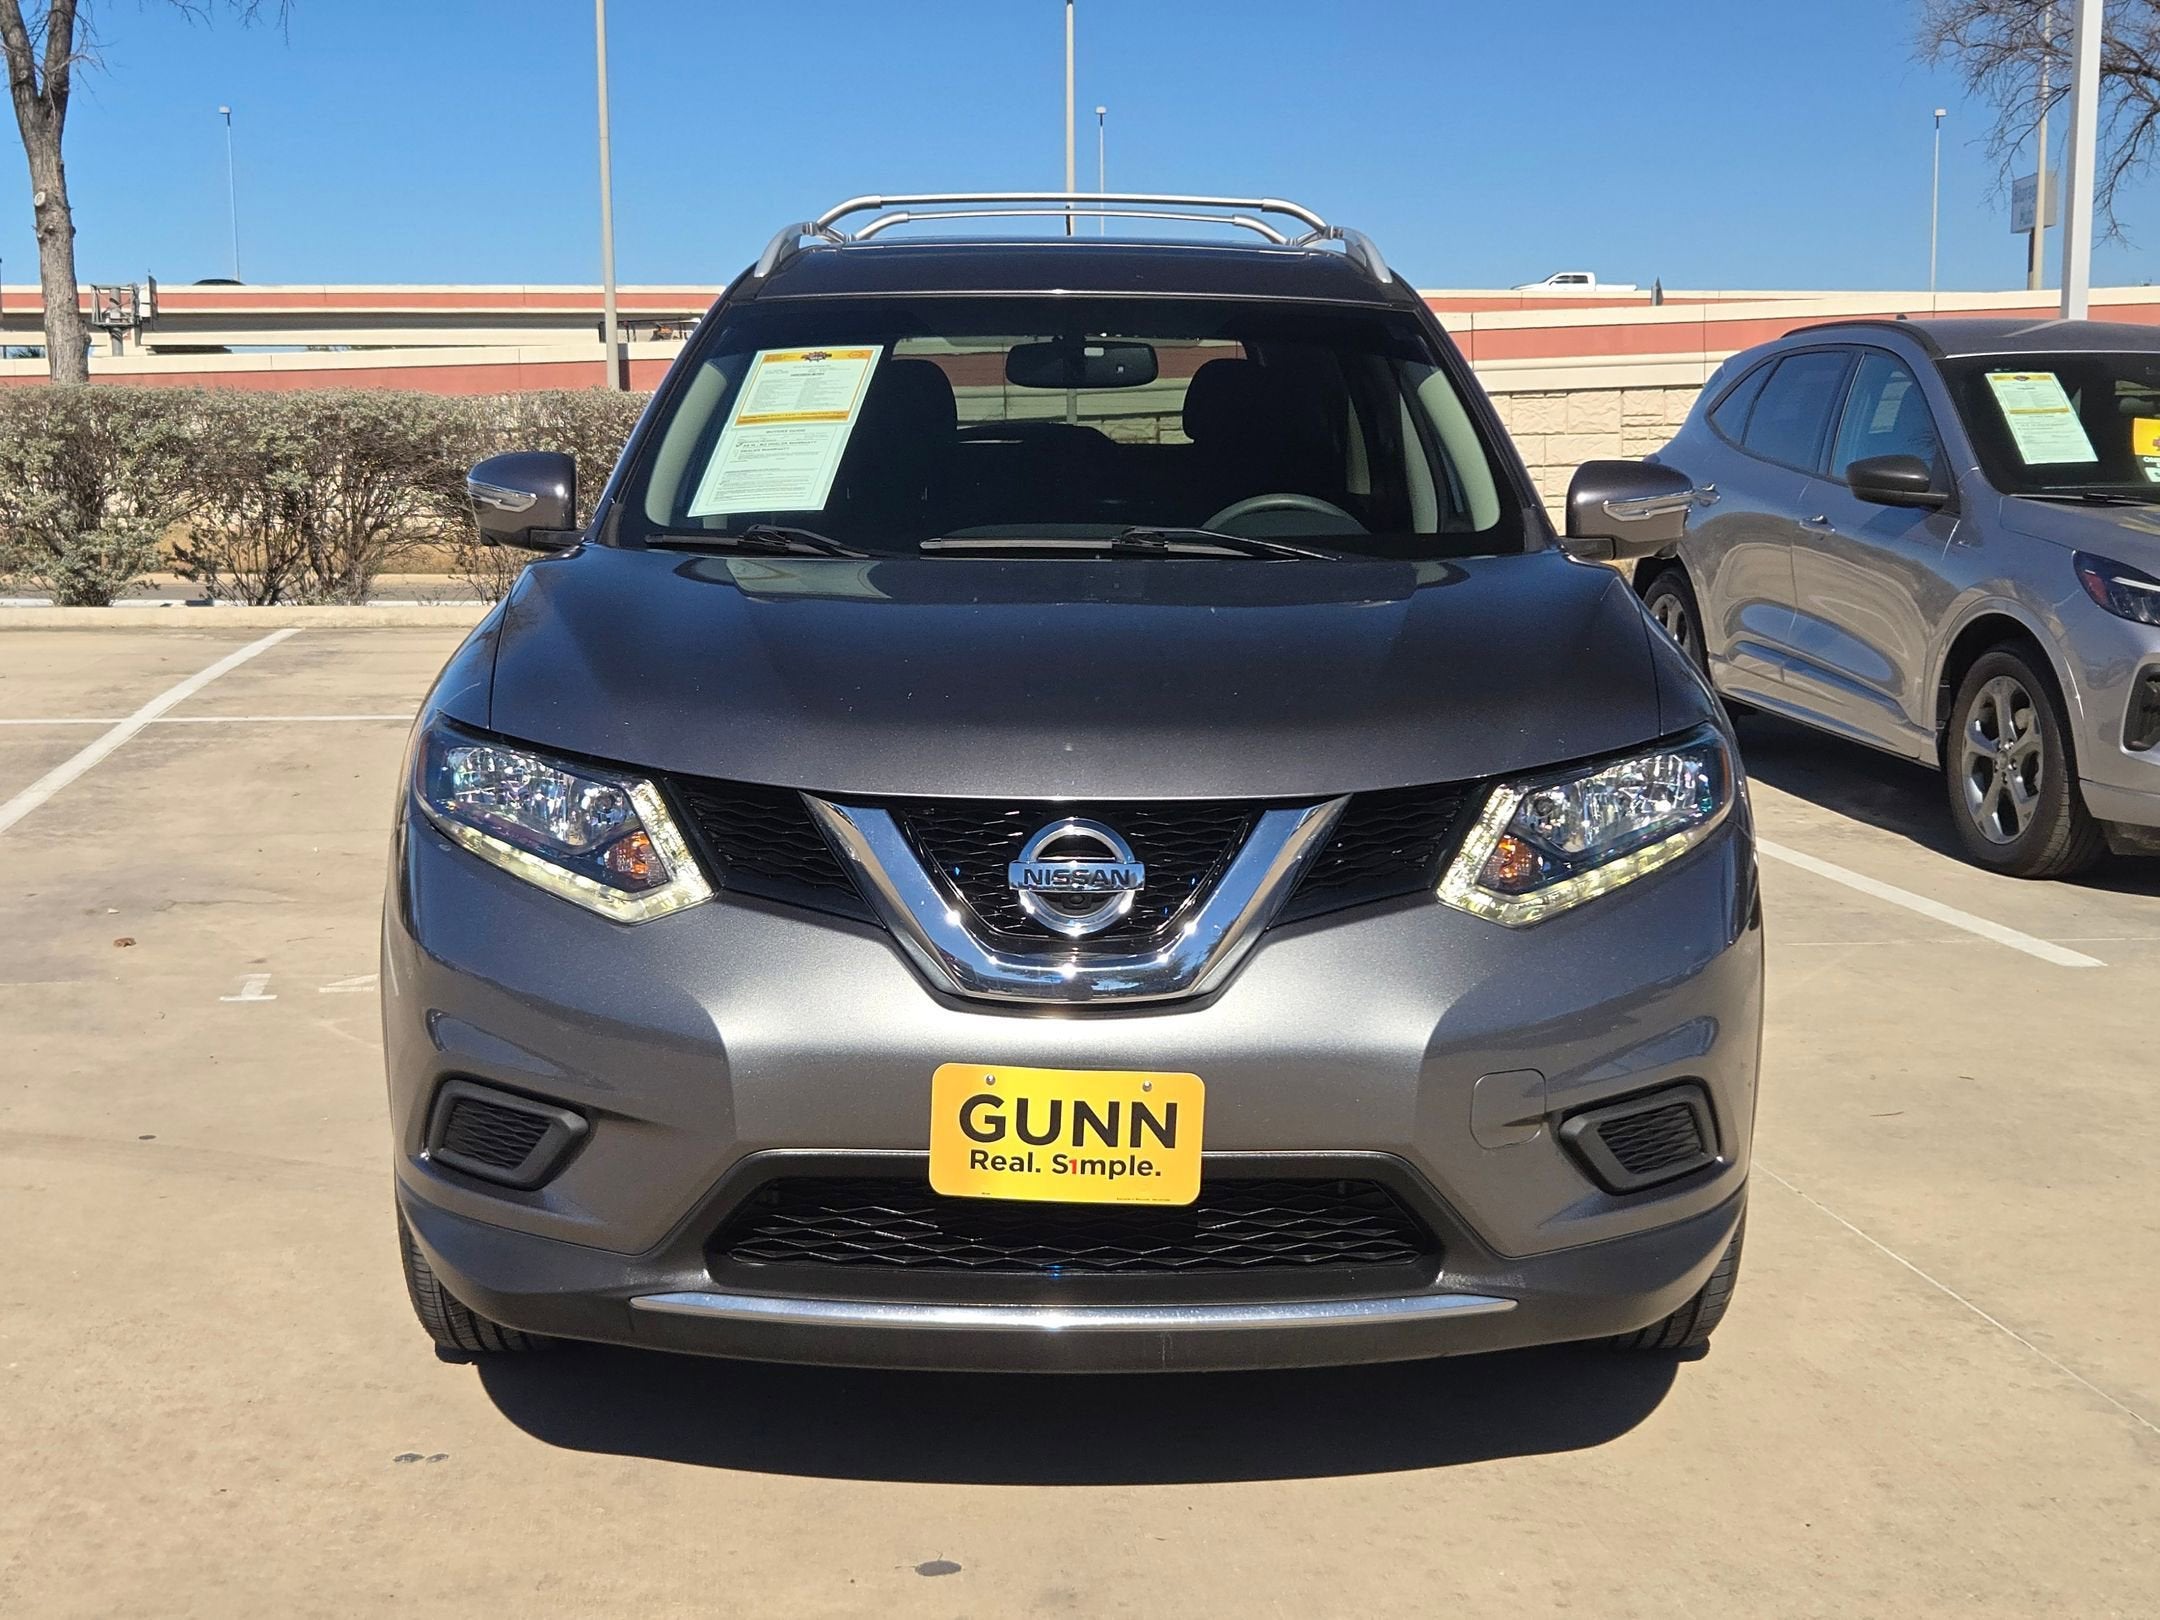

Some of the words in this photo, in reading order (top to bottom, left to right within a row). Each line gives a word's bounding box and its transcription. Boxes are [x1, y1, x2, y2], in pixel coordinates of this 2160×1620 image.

[1023, 868, 1130, 886] NISSAN
[959, 1094, 1178, 1149] GUNN
[970, 1149, 1041, 1173] Real.
